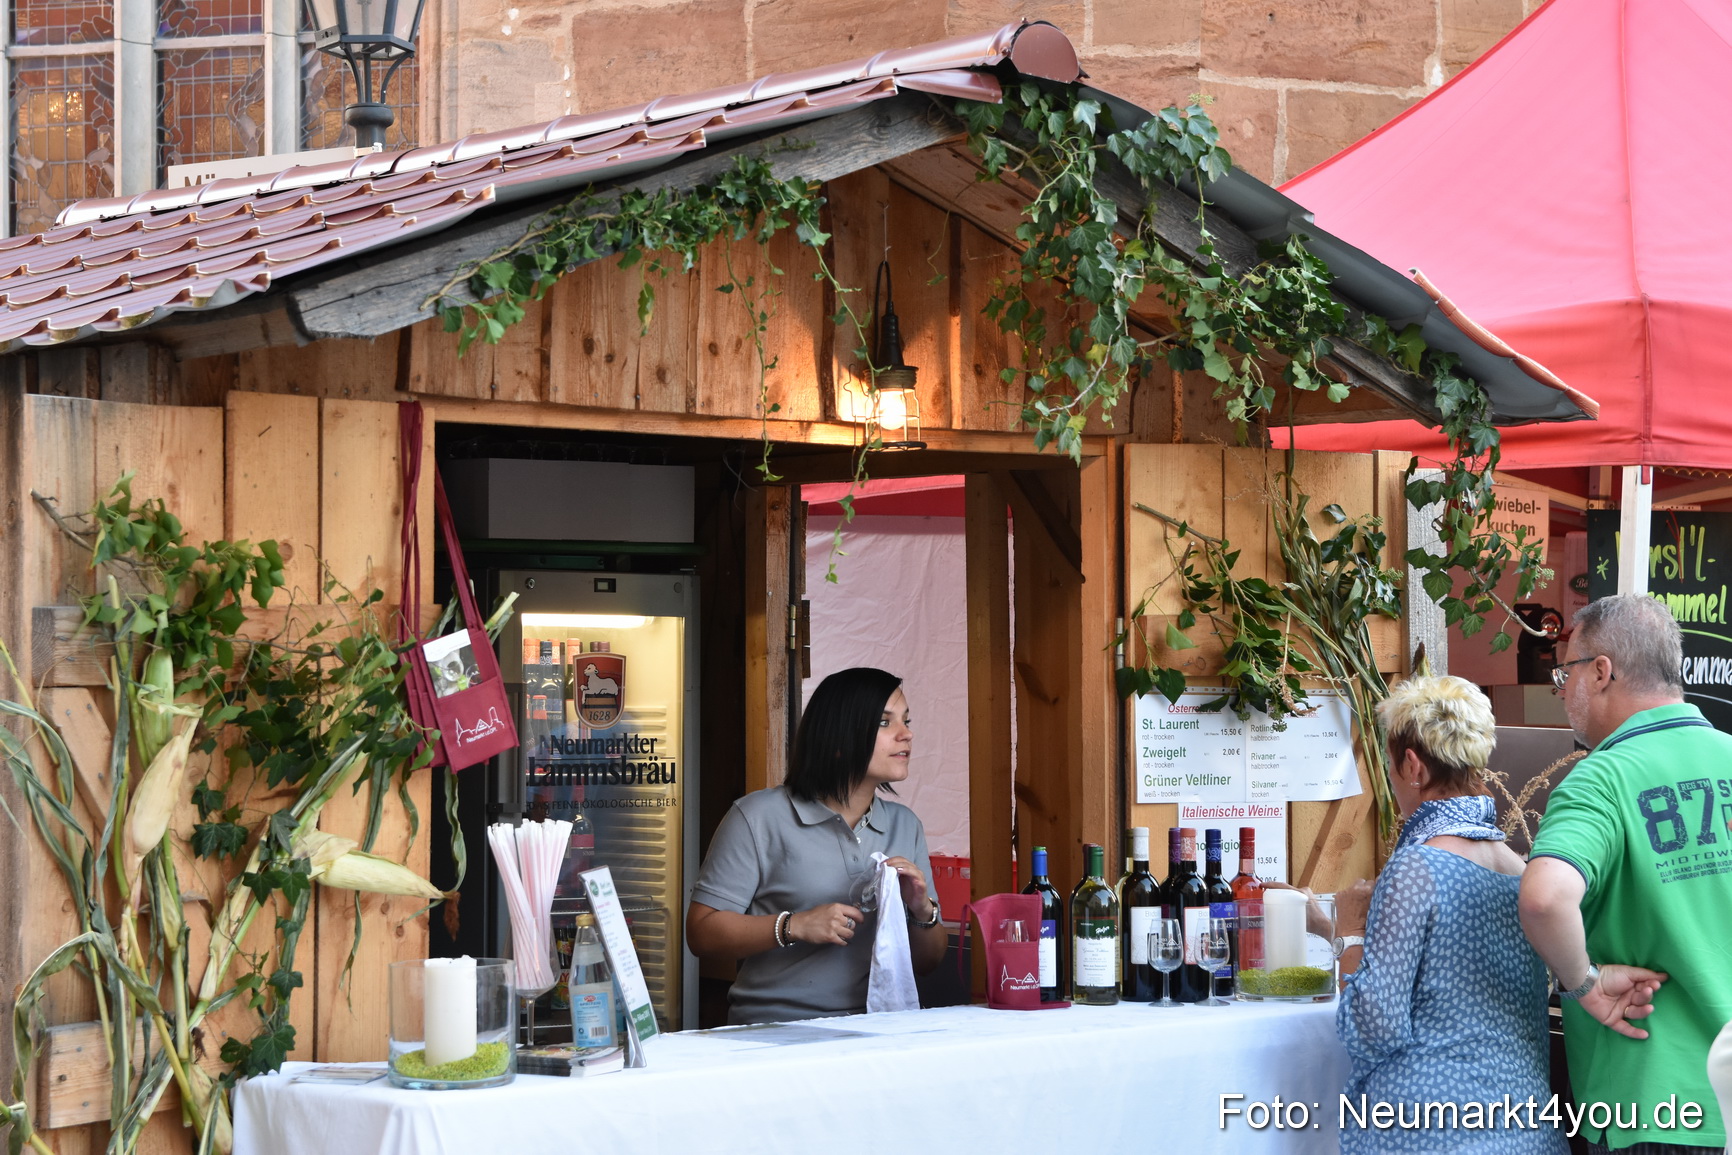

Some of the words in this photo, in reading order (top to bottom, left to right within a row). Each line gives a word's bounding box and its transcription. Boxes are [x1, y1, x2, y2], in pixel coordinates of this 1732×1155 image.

[1494, 497, 1541, 514] wiebel-
[588, 710, 611, 721] 1628
[1142, 719, 1155, 729] St.
[1159, 719, 1199, 729] Laurent
[1221, 728, 1236, 736] 15,50
[551, 733, 658, 755] Neumarkter
[1143, 746, 1186, 760] Zweigelt
[1223, 748, 1236, 756] 2,00
[1250, 752, 1276, 760] Rivaner
[528, 755, 676, 786] Lammsbräu
[1144, 774, 1182, 787] Grüner
[1185, 773, 1231, 786] Veltliner
[1251, 780, 1277, 788] Silvaner
[1680, 782, 1697, 791] REG
[1697, 780, 1710, 788] TM
[582, 797, 653, 809] ÖKOLOGISCHE
[656, 798, 677, 807] BIER
[1182, 804, 1245, 817] Italienische
[1248, 804, 1283, 817] Weine:
[1637, 778, 1717, 854] 87
[1257, 856, 1272, 864] 13,50
[1656, 849, 1732, 870] MIDTOW
